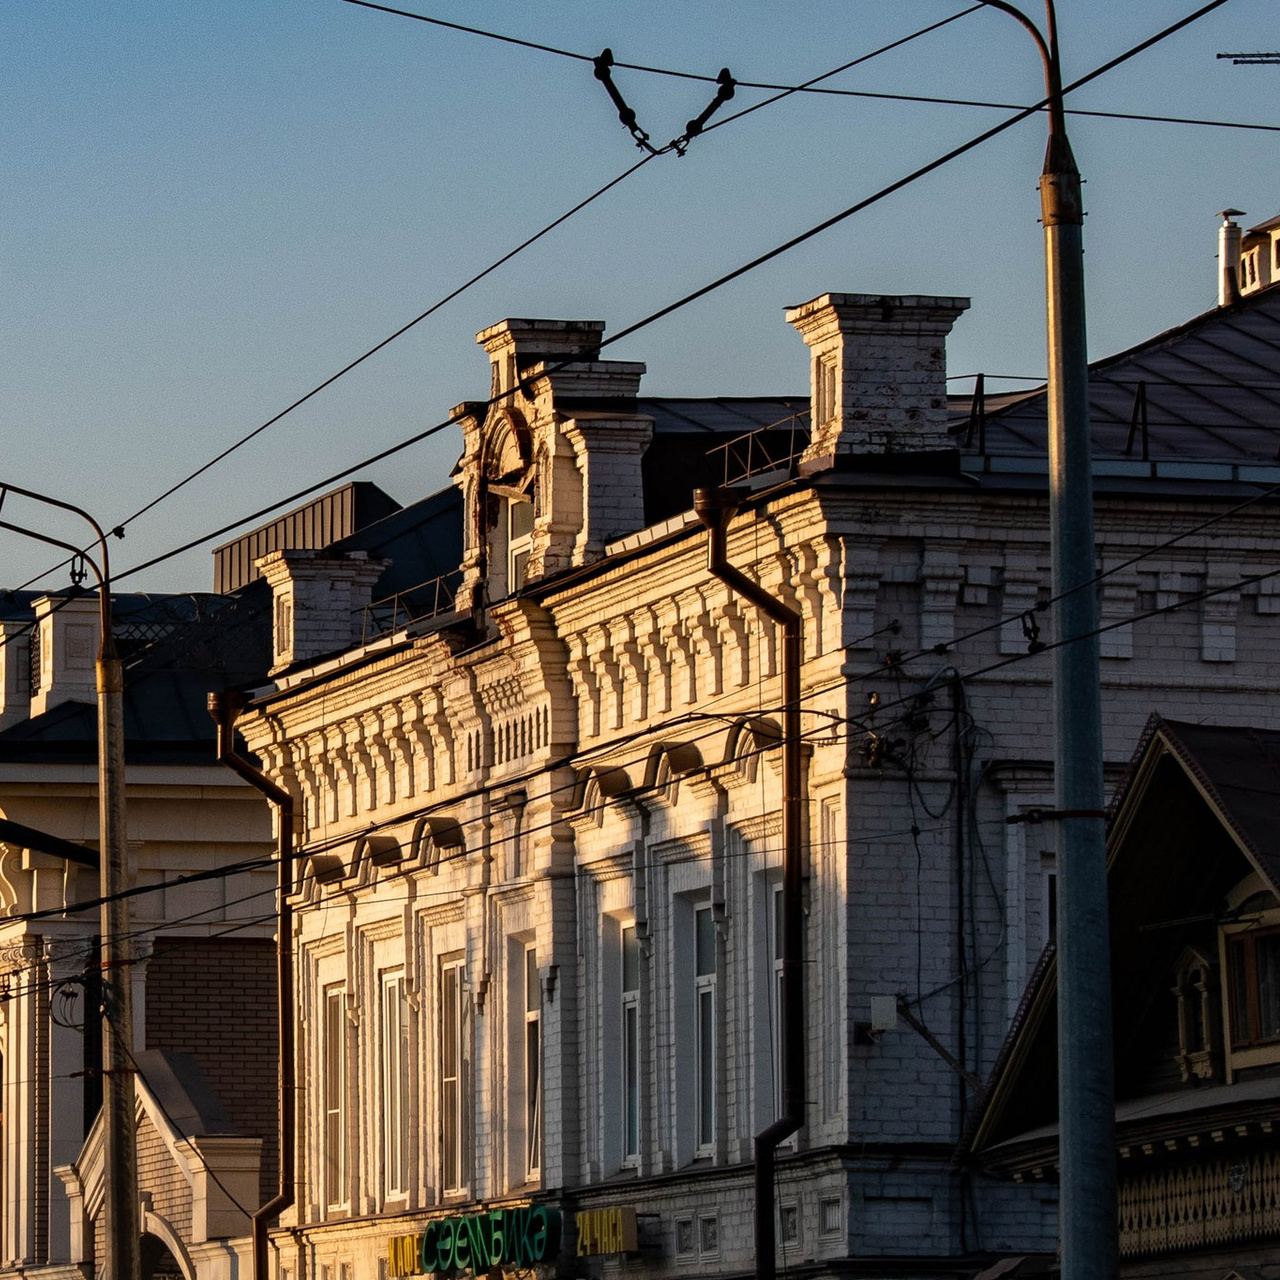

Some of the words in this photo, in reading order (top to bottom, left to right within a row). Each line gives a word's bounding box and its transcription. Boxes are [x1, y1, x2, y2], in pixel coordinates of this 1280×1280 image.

[388, 1233, 421, 1277] КАФЕ
[577, 1211, 590, 1257] 24
[593, 1206, 623, 1255] ЧАСА
